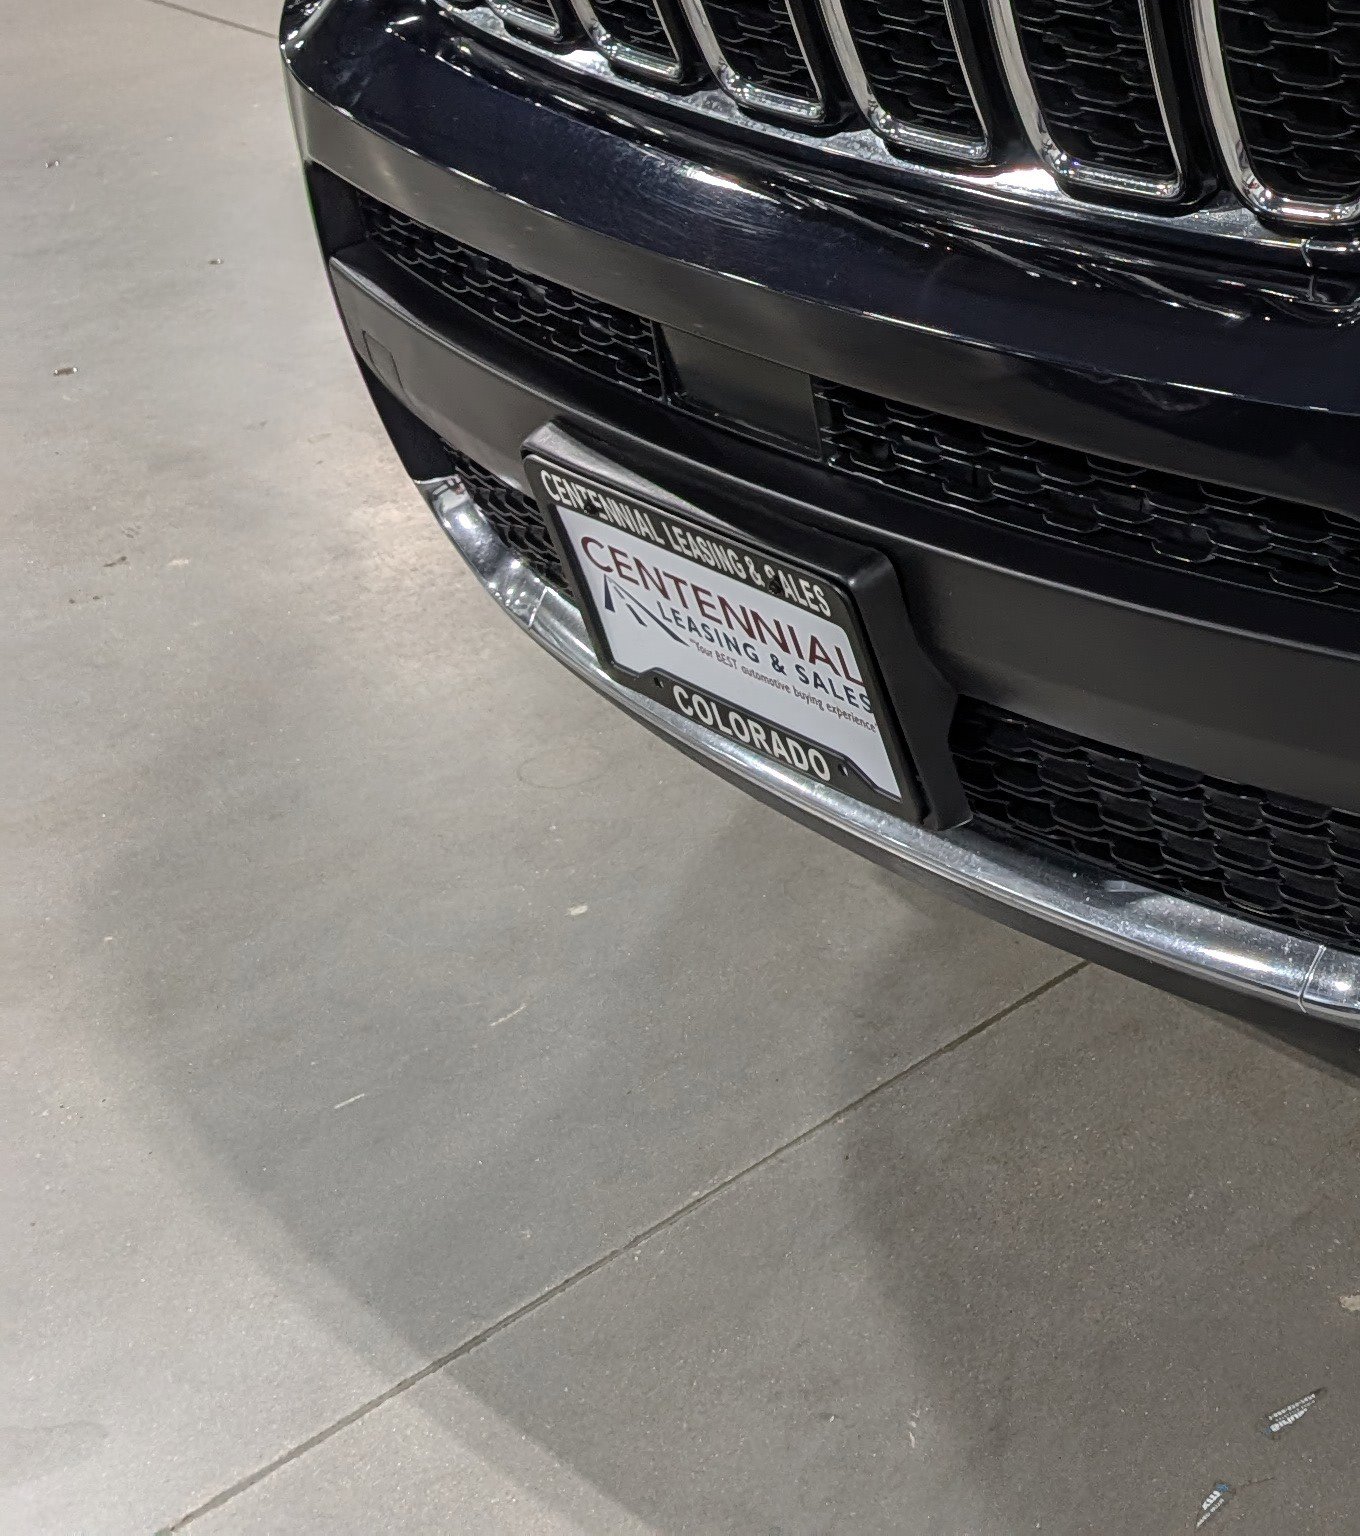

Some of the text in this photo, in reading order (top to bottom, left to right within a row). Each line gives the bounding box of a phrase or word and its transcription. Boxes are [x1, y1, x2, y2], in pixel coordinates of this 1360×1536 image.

[541, 469, 666, 545] CENTENNIAL
[661, 521, 747, 580] LEASING
[744, 555, 766, 588] &
[581, 536, 866, 687] CENTENNIAL
[656, 600, 875, 714] LEASING & SALES
[673, 684, 831, 782] COLORADO
[715, 650, 738, 670] BEST
[741, 665, 791, 694] automotive
[792, 685, 825, 712] buying
